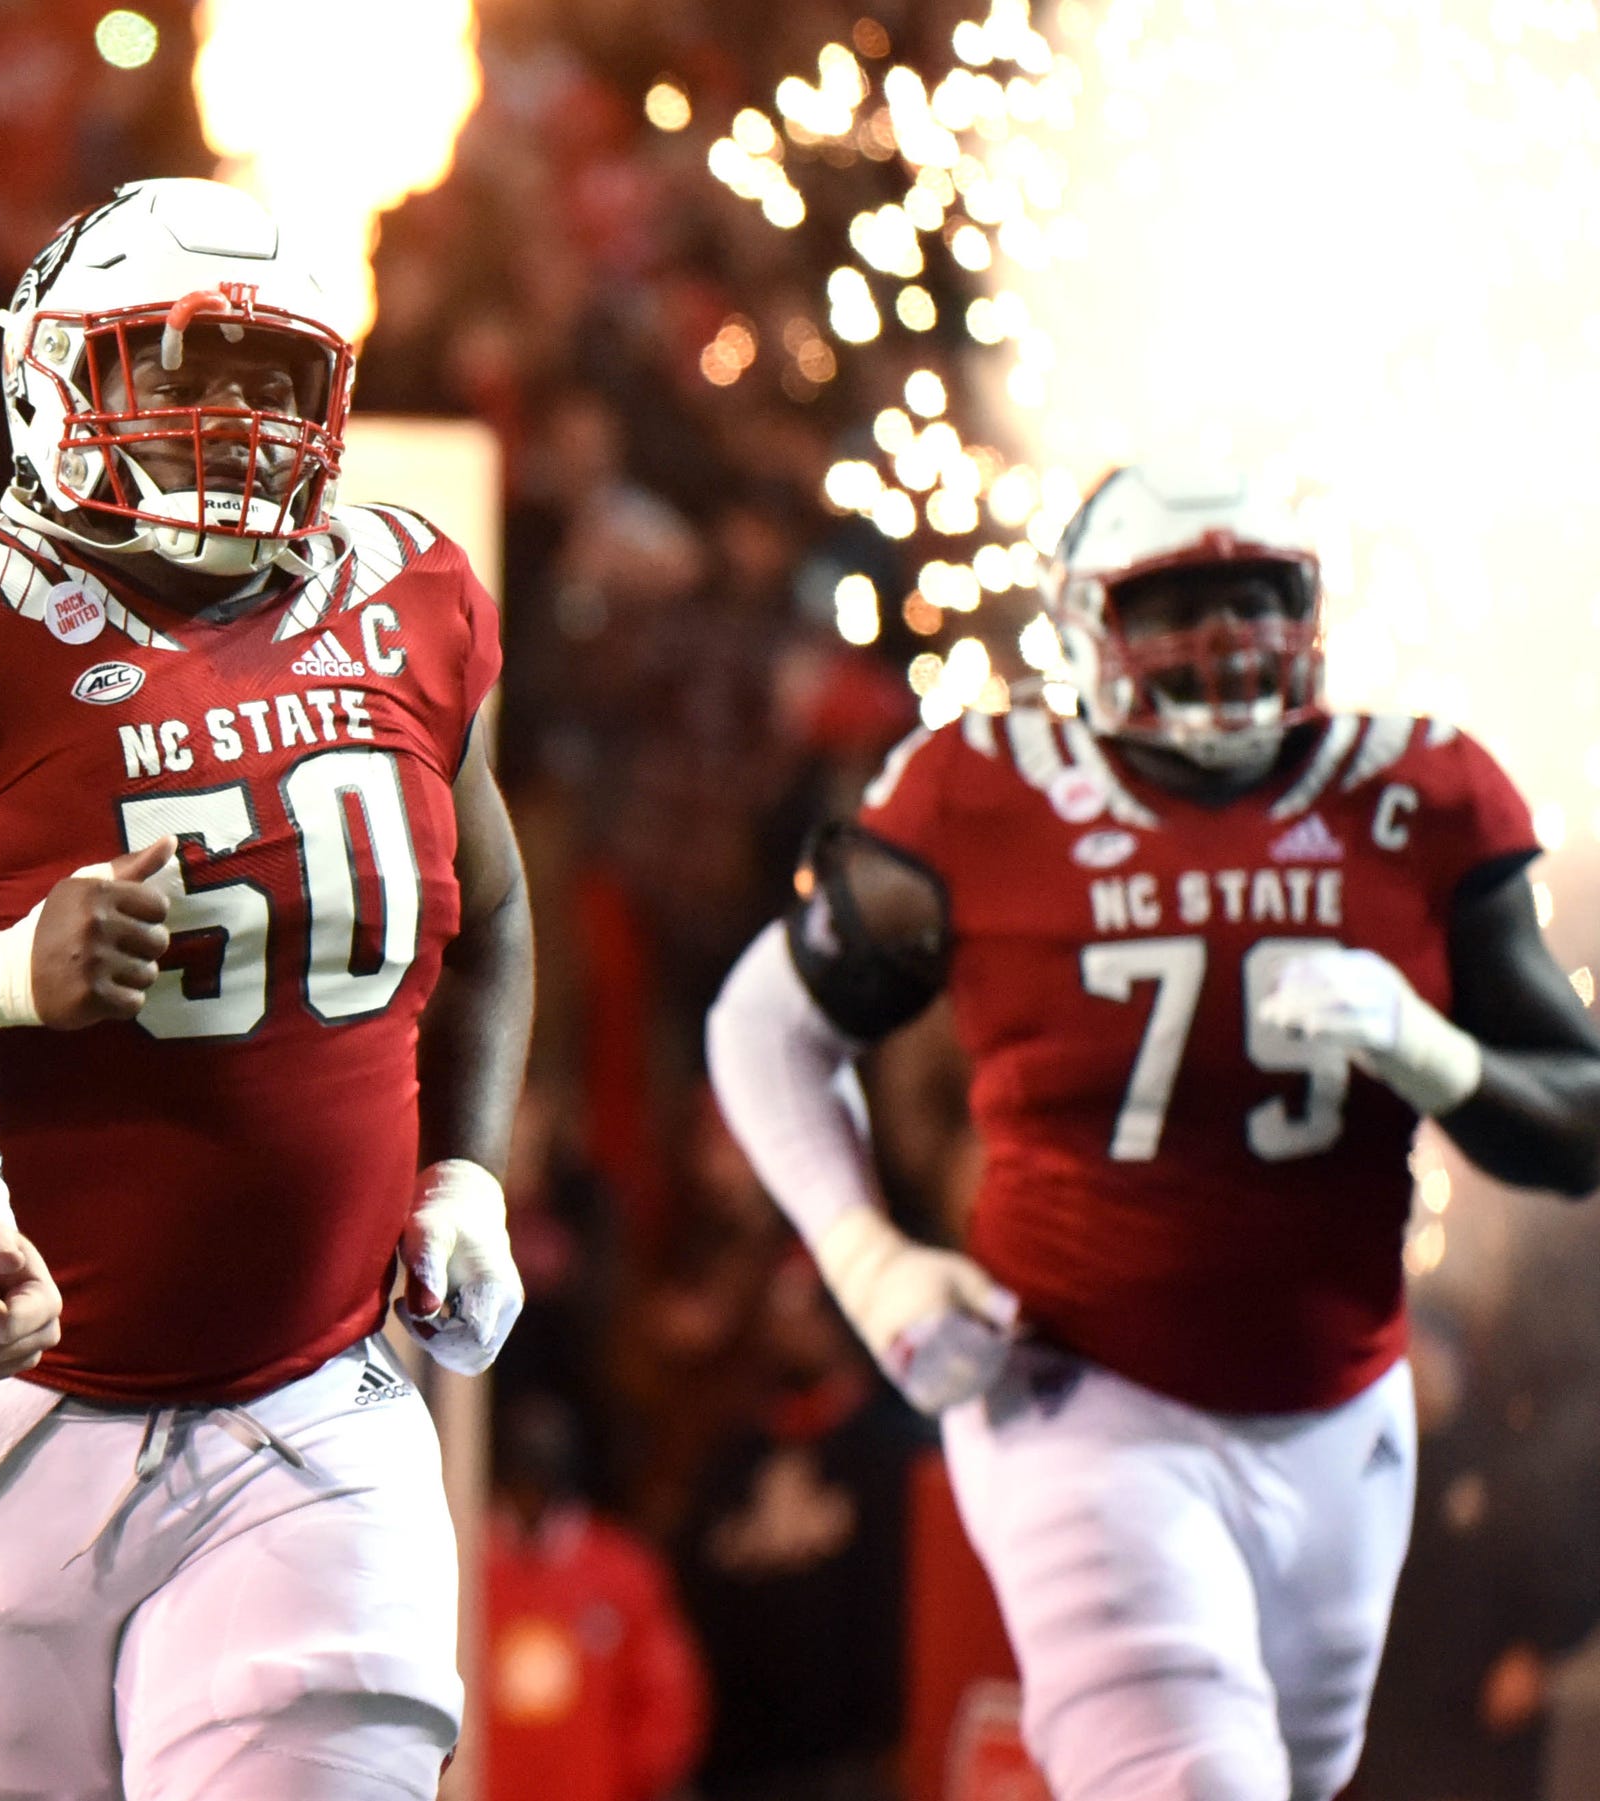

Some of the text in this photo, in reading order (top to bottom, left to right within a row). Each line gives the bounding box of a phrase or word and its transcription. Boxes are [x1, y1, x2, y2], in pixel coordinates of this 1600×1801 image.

[55, 591, 87, 618] PACK
[58, 603, 100, 635] UNITED
[291, 660, 366, 678] adidas
[360, 602, 408, 678] C
[87, 667, 132, 693] ACC
[117, 689, 375, 779] NC STATE
[1371, 782, 1419, 852] C
[117, 745, 424, 1043] 50
[1090, 867, 1343, 934] NC STATE
